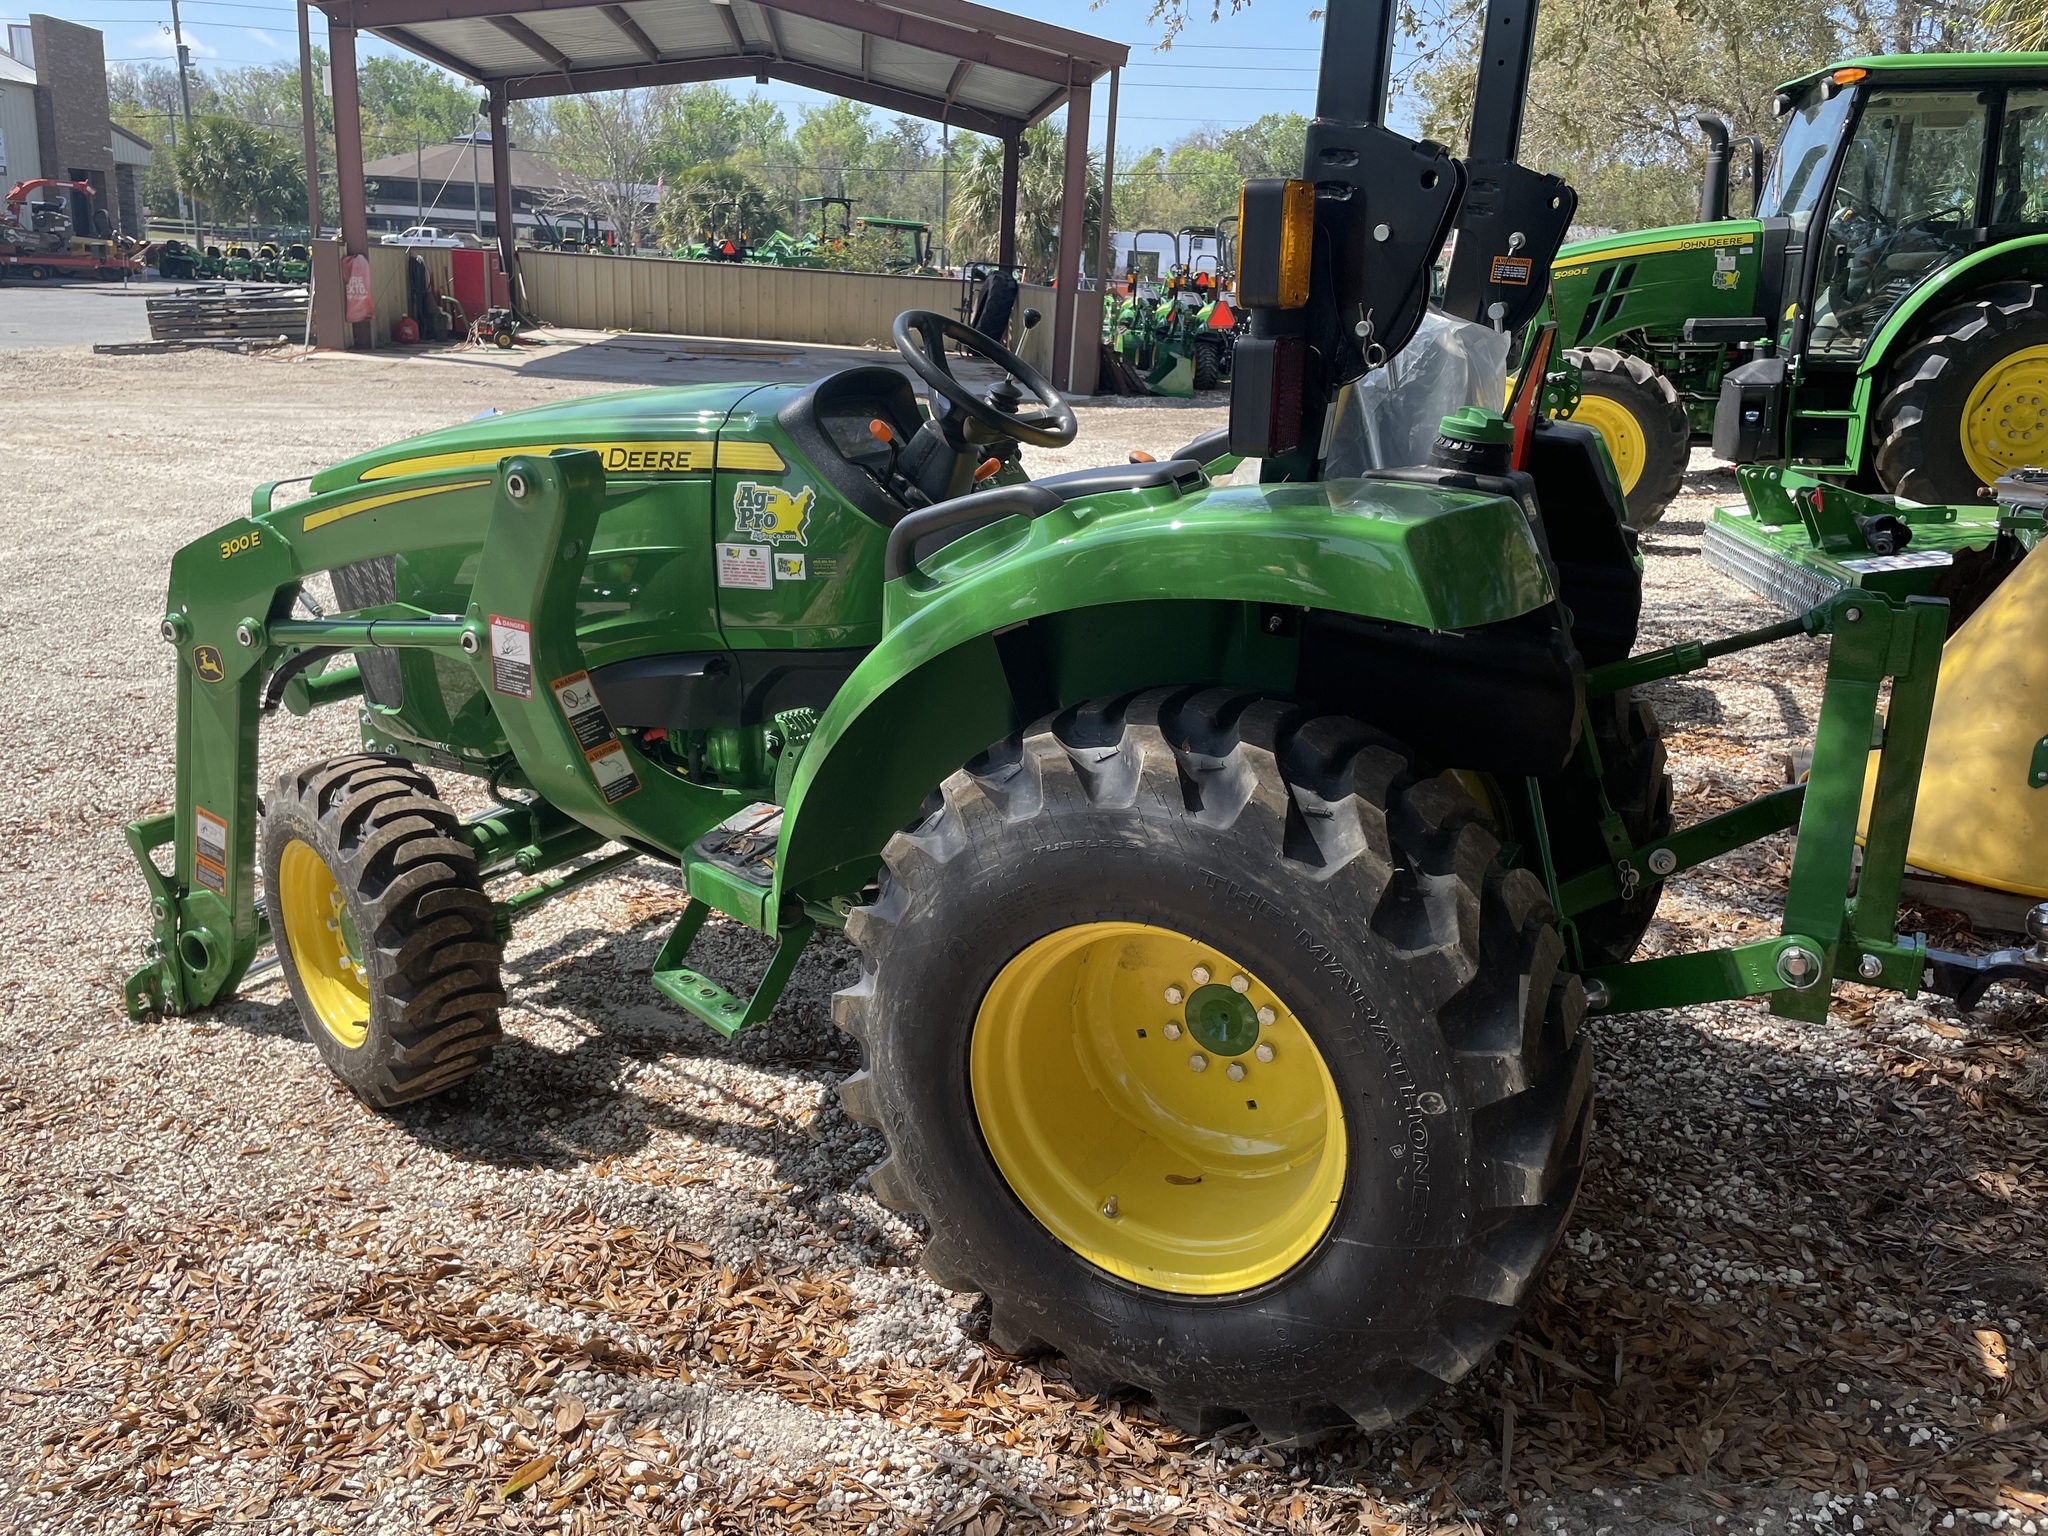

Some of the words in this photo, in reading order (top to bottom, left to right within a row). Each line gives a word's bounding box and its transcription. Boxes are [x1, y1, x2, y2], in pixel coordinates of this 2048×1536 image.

[1678, 241, 1706, 250] JOHN
[1708, 237, 1743, 247] DEERE
[608, 448, 691, 468] DEERE
[738, 486, 776, 511] Ag-
[739, 508, 776, 530] Pro
[501, 619, 526, 631] DANGER
[559, 671, 587, 688] WARNING
[593, 744, 621, 759] WARNING
[1032, 839, 1140, 855] TUBELESS
[1198, 867, 1286, 923] THE
[1294, 928, 1431, 1242] MARATHONER
